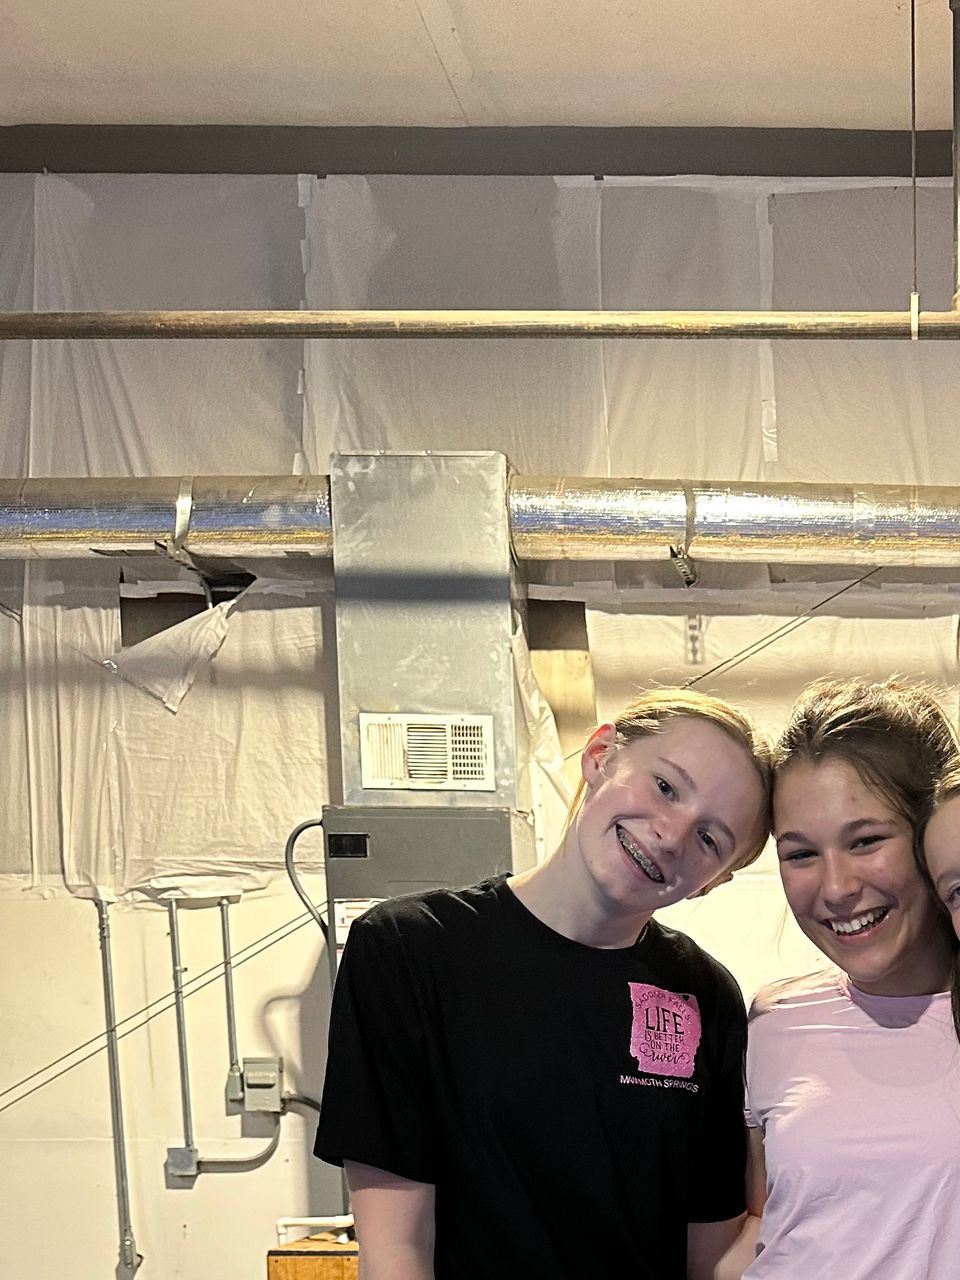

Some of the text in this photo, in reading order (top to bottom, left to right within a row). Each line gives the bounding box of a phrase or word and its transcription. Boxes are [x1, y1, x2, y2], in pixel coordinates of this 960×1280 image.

[645, 1006, 685, 1035] LIFE
[645, 1030, 652, 1042] IS
[650, 1040, 680, 1053] ON THE
[663, 1078, 700, 1093] SPRINGS
